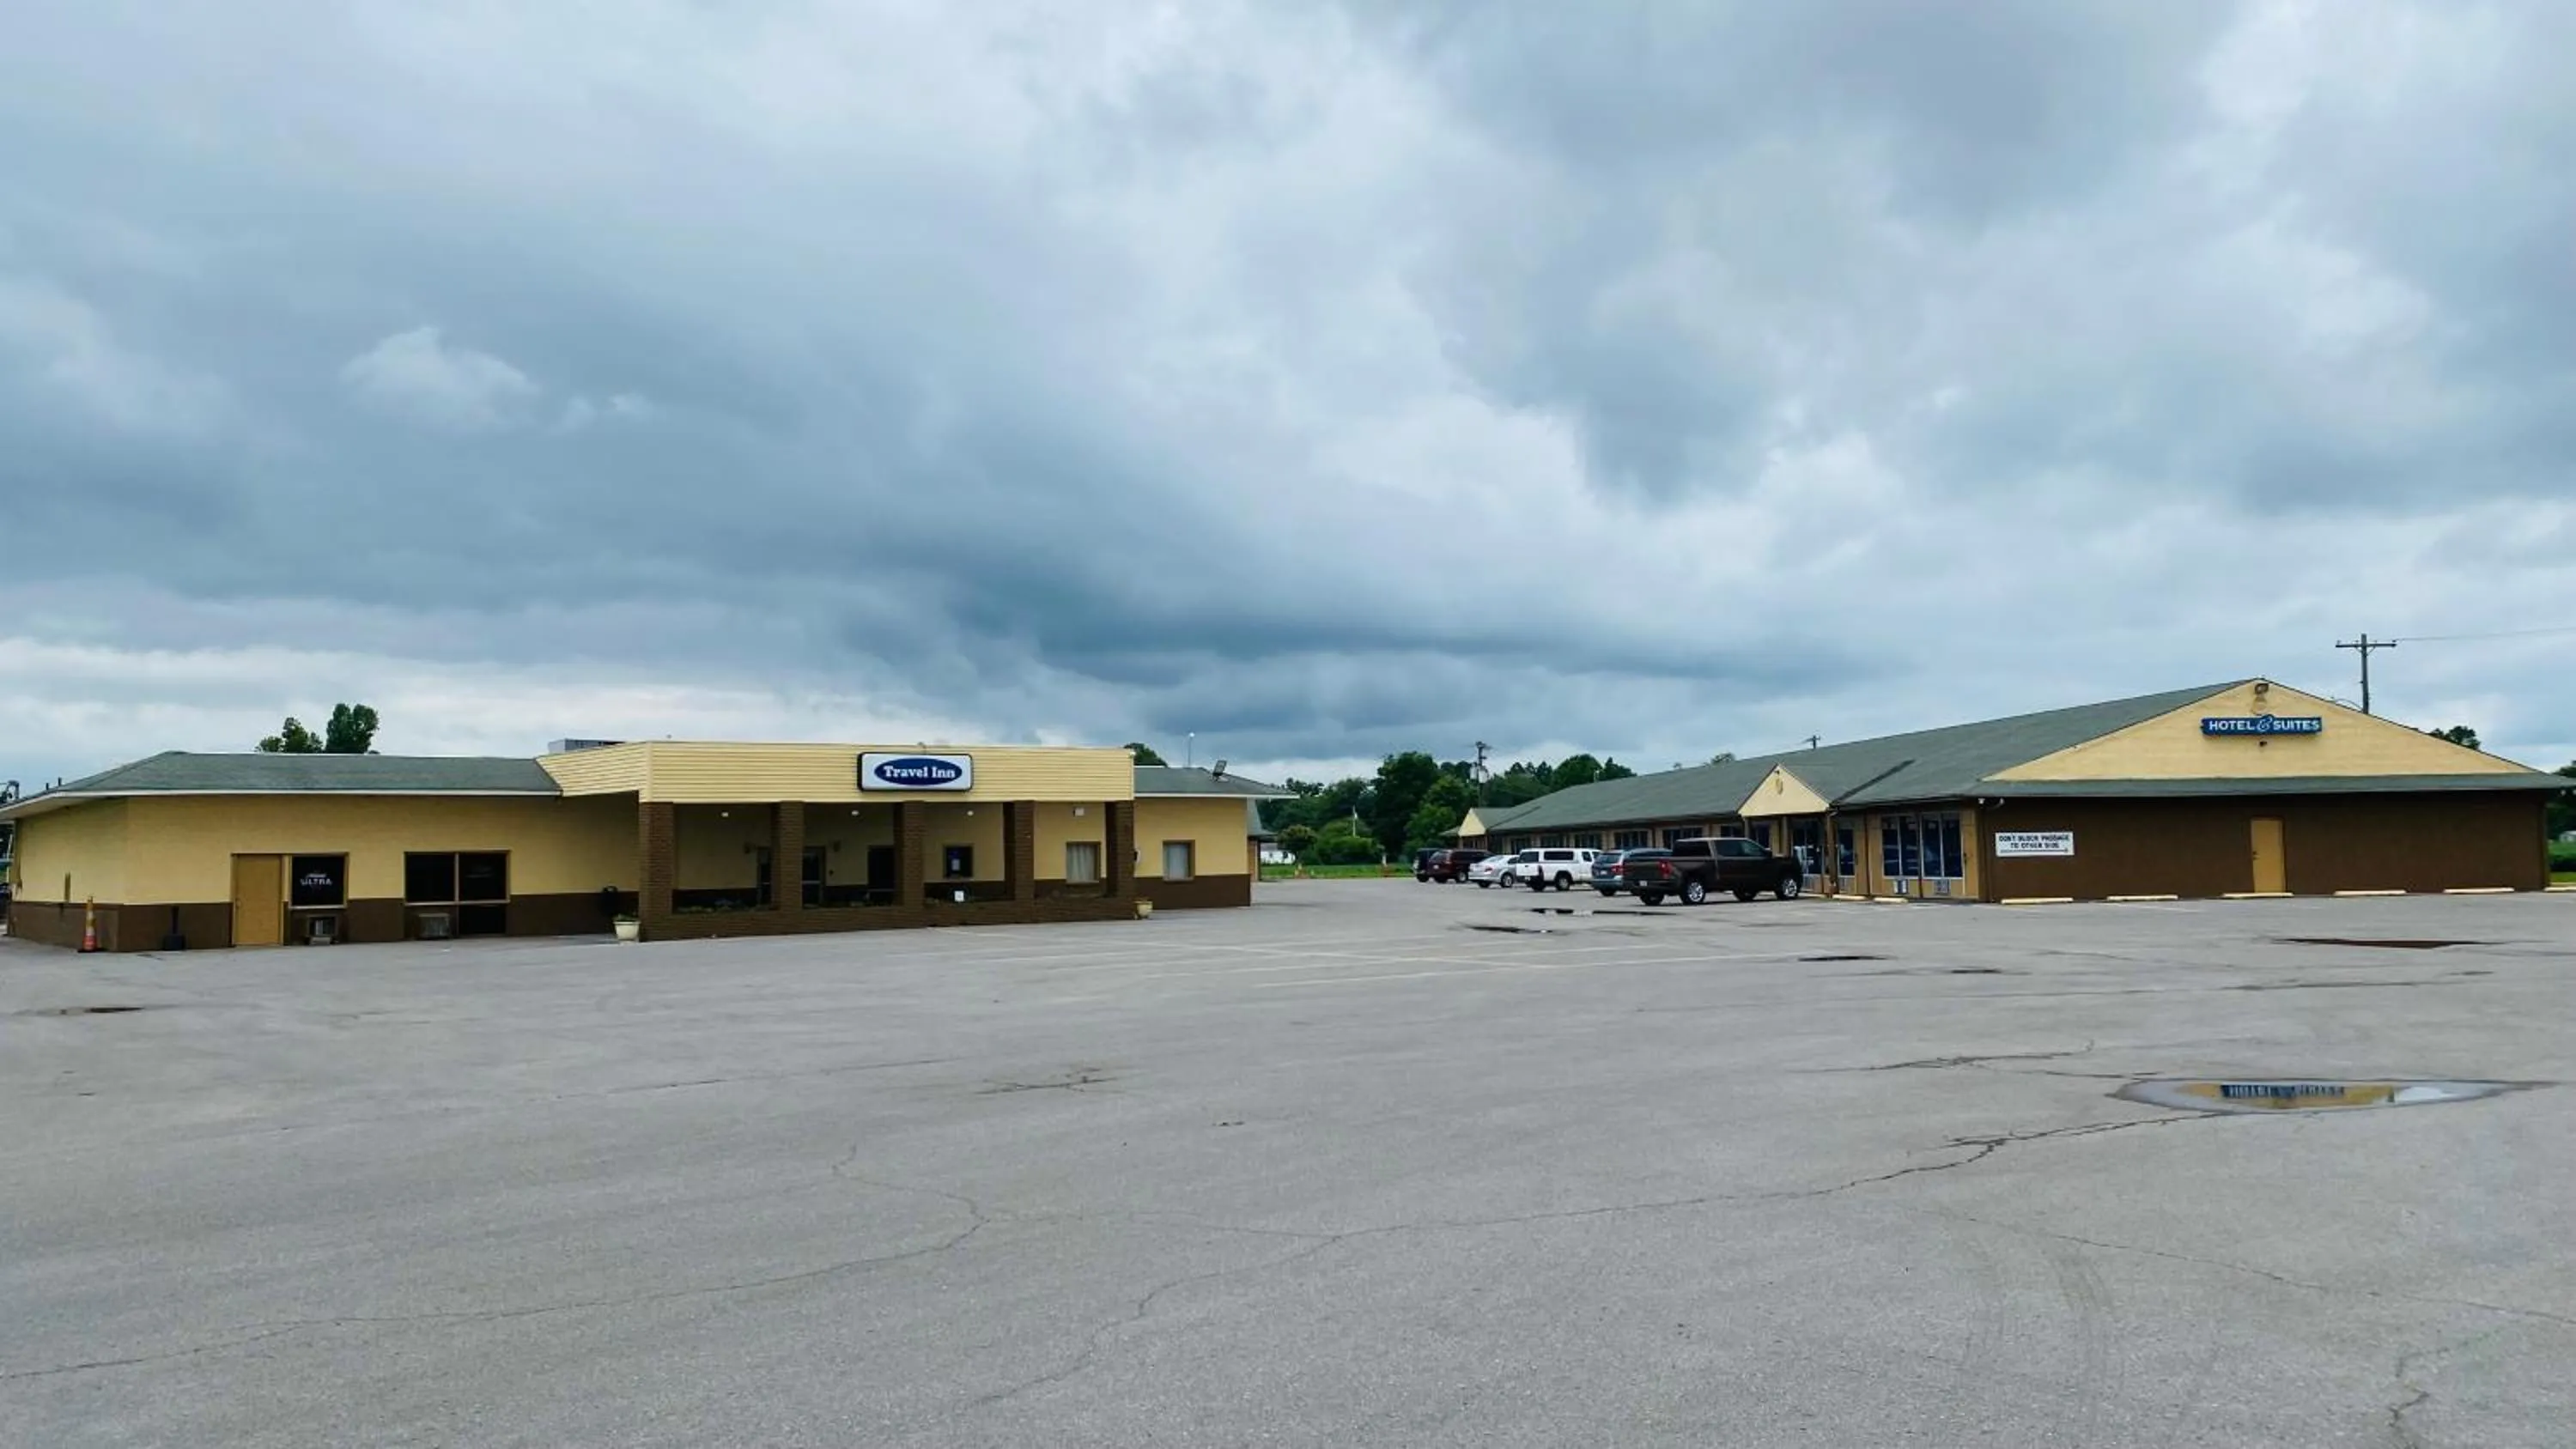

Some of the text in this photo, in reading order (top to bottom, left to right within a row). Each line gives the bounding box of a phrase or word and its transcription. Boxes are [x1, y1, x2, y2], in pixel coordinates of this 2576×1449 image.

[2208, 716, 2319, 732] HOTEL & SUITES
[884, 765, 956, 779] Travel Inn
